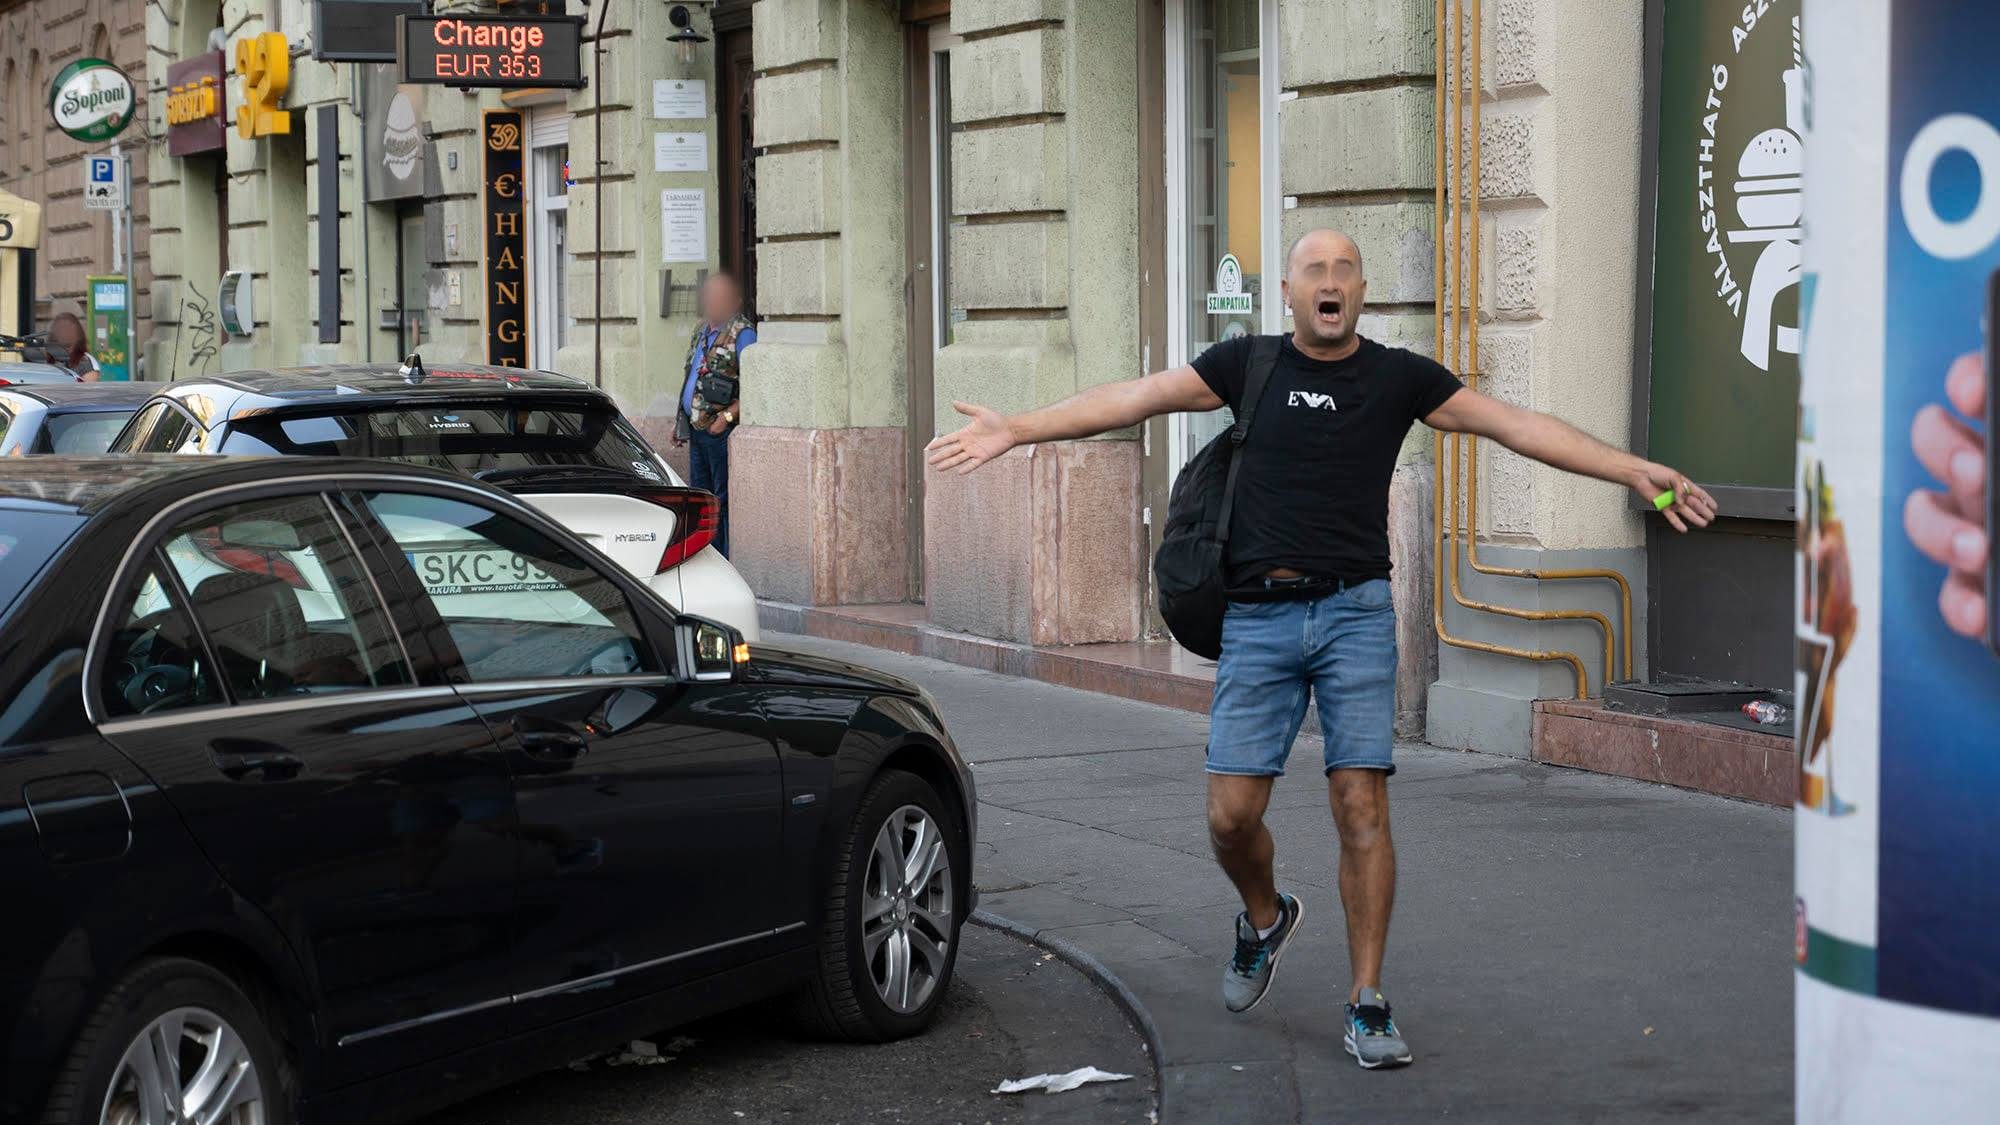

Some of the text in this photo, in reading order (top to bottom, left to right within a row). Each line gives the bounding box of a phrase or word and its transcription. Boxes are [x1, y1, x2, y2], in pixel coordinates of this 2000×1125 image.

[433, 19, 544, 53] Change
[1731, 0, 1776, 54] ASZ
[435, 53, 541, 78] EUR 353
[236, 31, 290, 139] 32
[61, 82, 125, 117] Soproni
[488, 123, 520, 151] 32
[96, 161, 109, 180] P
[1208, 297, 1250, 311] SZIMPATIKA
[614, 533, 651, 543] HYBRID
